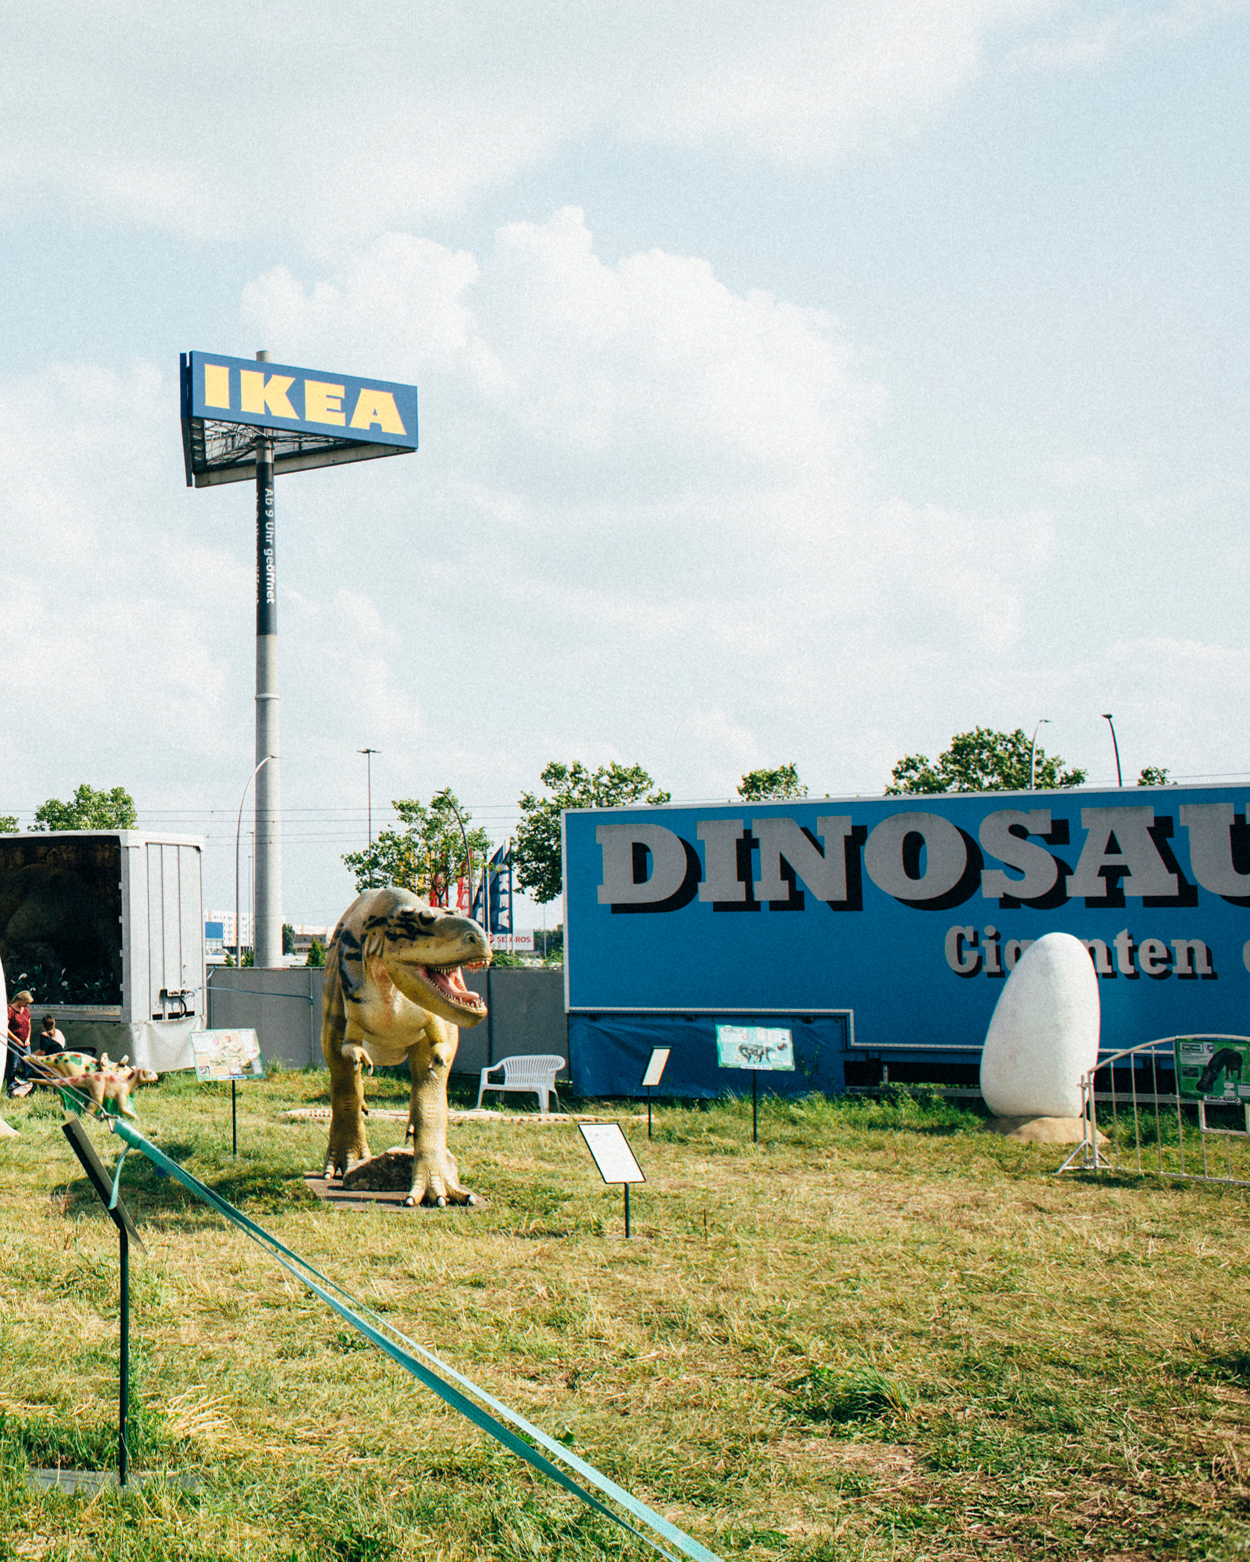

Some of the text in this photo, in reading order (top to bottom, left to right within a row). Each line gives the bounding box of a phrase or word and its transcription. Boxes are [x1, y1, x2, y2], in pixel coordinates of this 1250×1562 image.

[204, 364, 407, 435] IKEA
[264, 488, 276, 604] Ab 9 Uhr geöffnet
[596, 802, 1250, 911] DINOSAU
[945, 925, 1215, 976] Ginten
